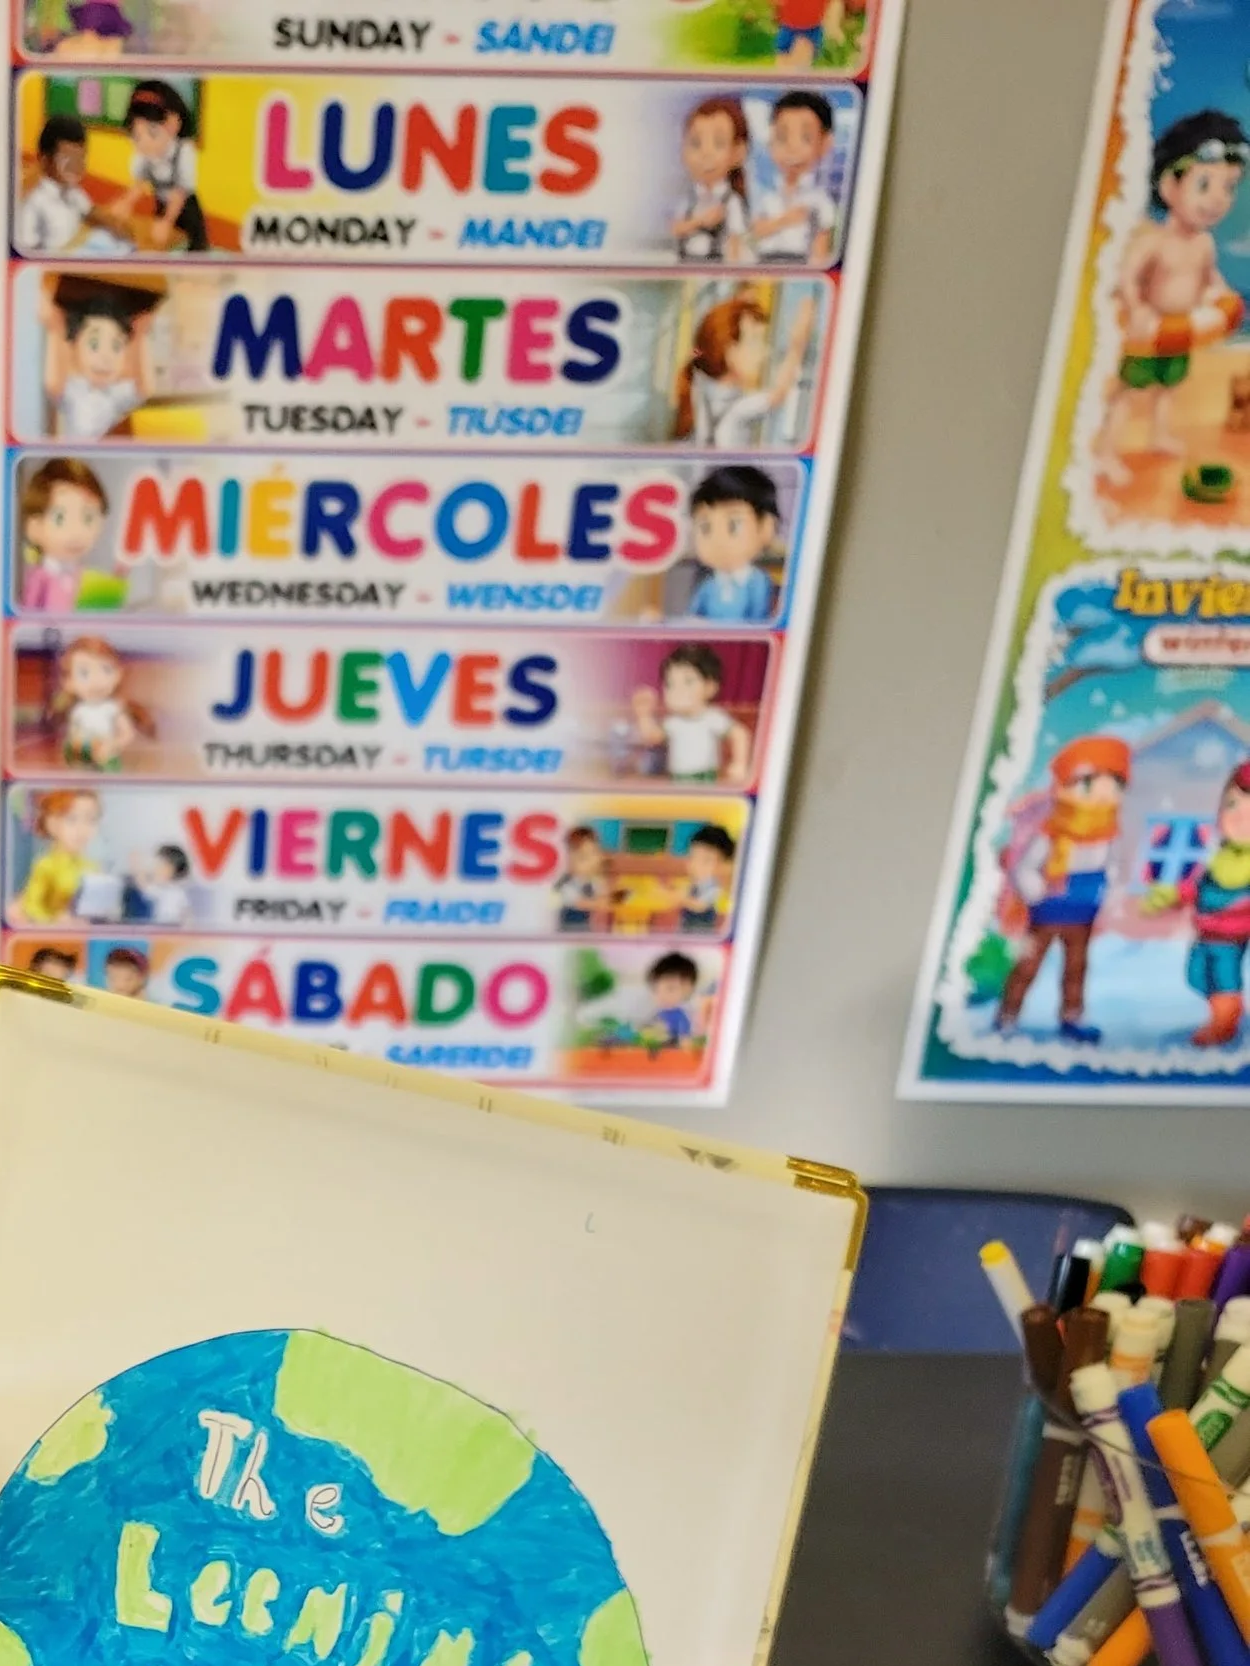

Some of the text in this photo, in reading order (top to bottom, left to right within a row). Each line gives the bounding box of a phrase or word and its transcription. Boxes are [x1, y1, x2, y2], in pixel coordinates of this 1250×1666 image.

[273, 17, 432, 51] SUNDAY
[474, 19, 616, 55] SANDEI
[263, 101, 602, 197] LUNES
[251, 215, 417, 247] MONDAY
[460, 218, 608, 249] MANDEI
[213, 294, 623, 384] MARTES
[243, 404, 403, 434] TUESDAY
[124, 464, 680, 562] MIÉRCOLES
[191, 580, 406, 610] WEDNESDAY
[445, 583, 604, 611] WENSDEI
[212, 649, 559, 727] JUEVES
[203, 742, 382, 770] THURSDAY
[183, 807, 560, 884] VIERNES
[232, 898, 347, 924] FRIDAY
[170, 944, 551, 1030] SÁBADO
[197, 1409, 347, 1537] The
